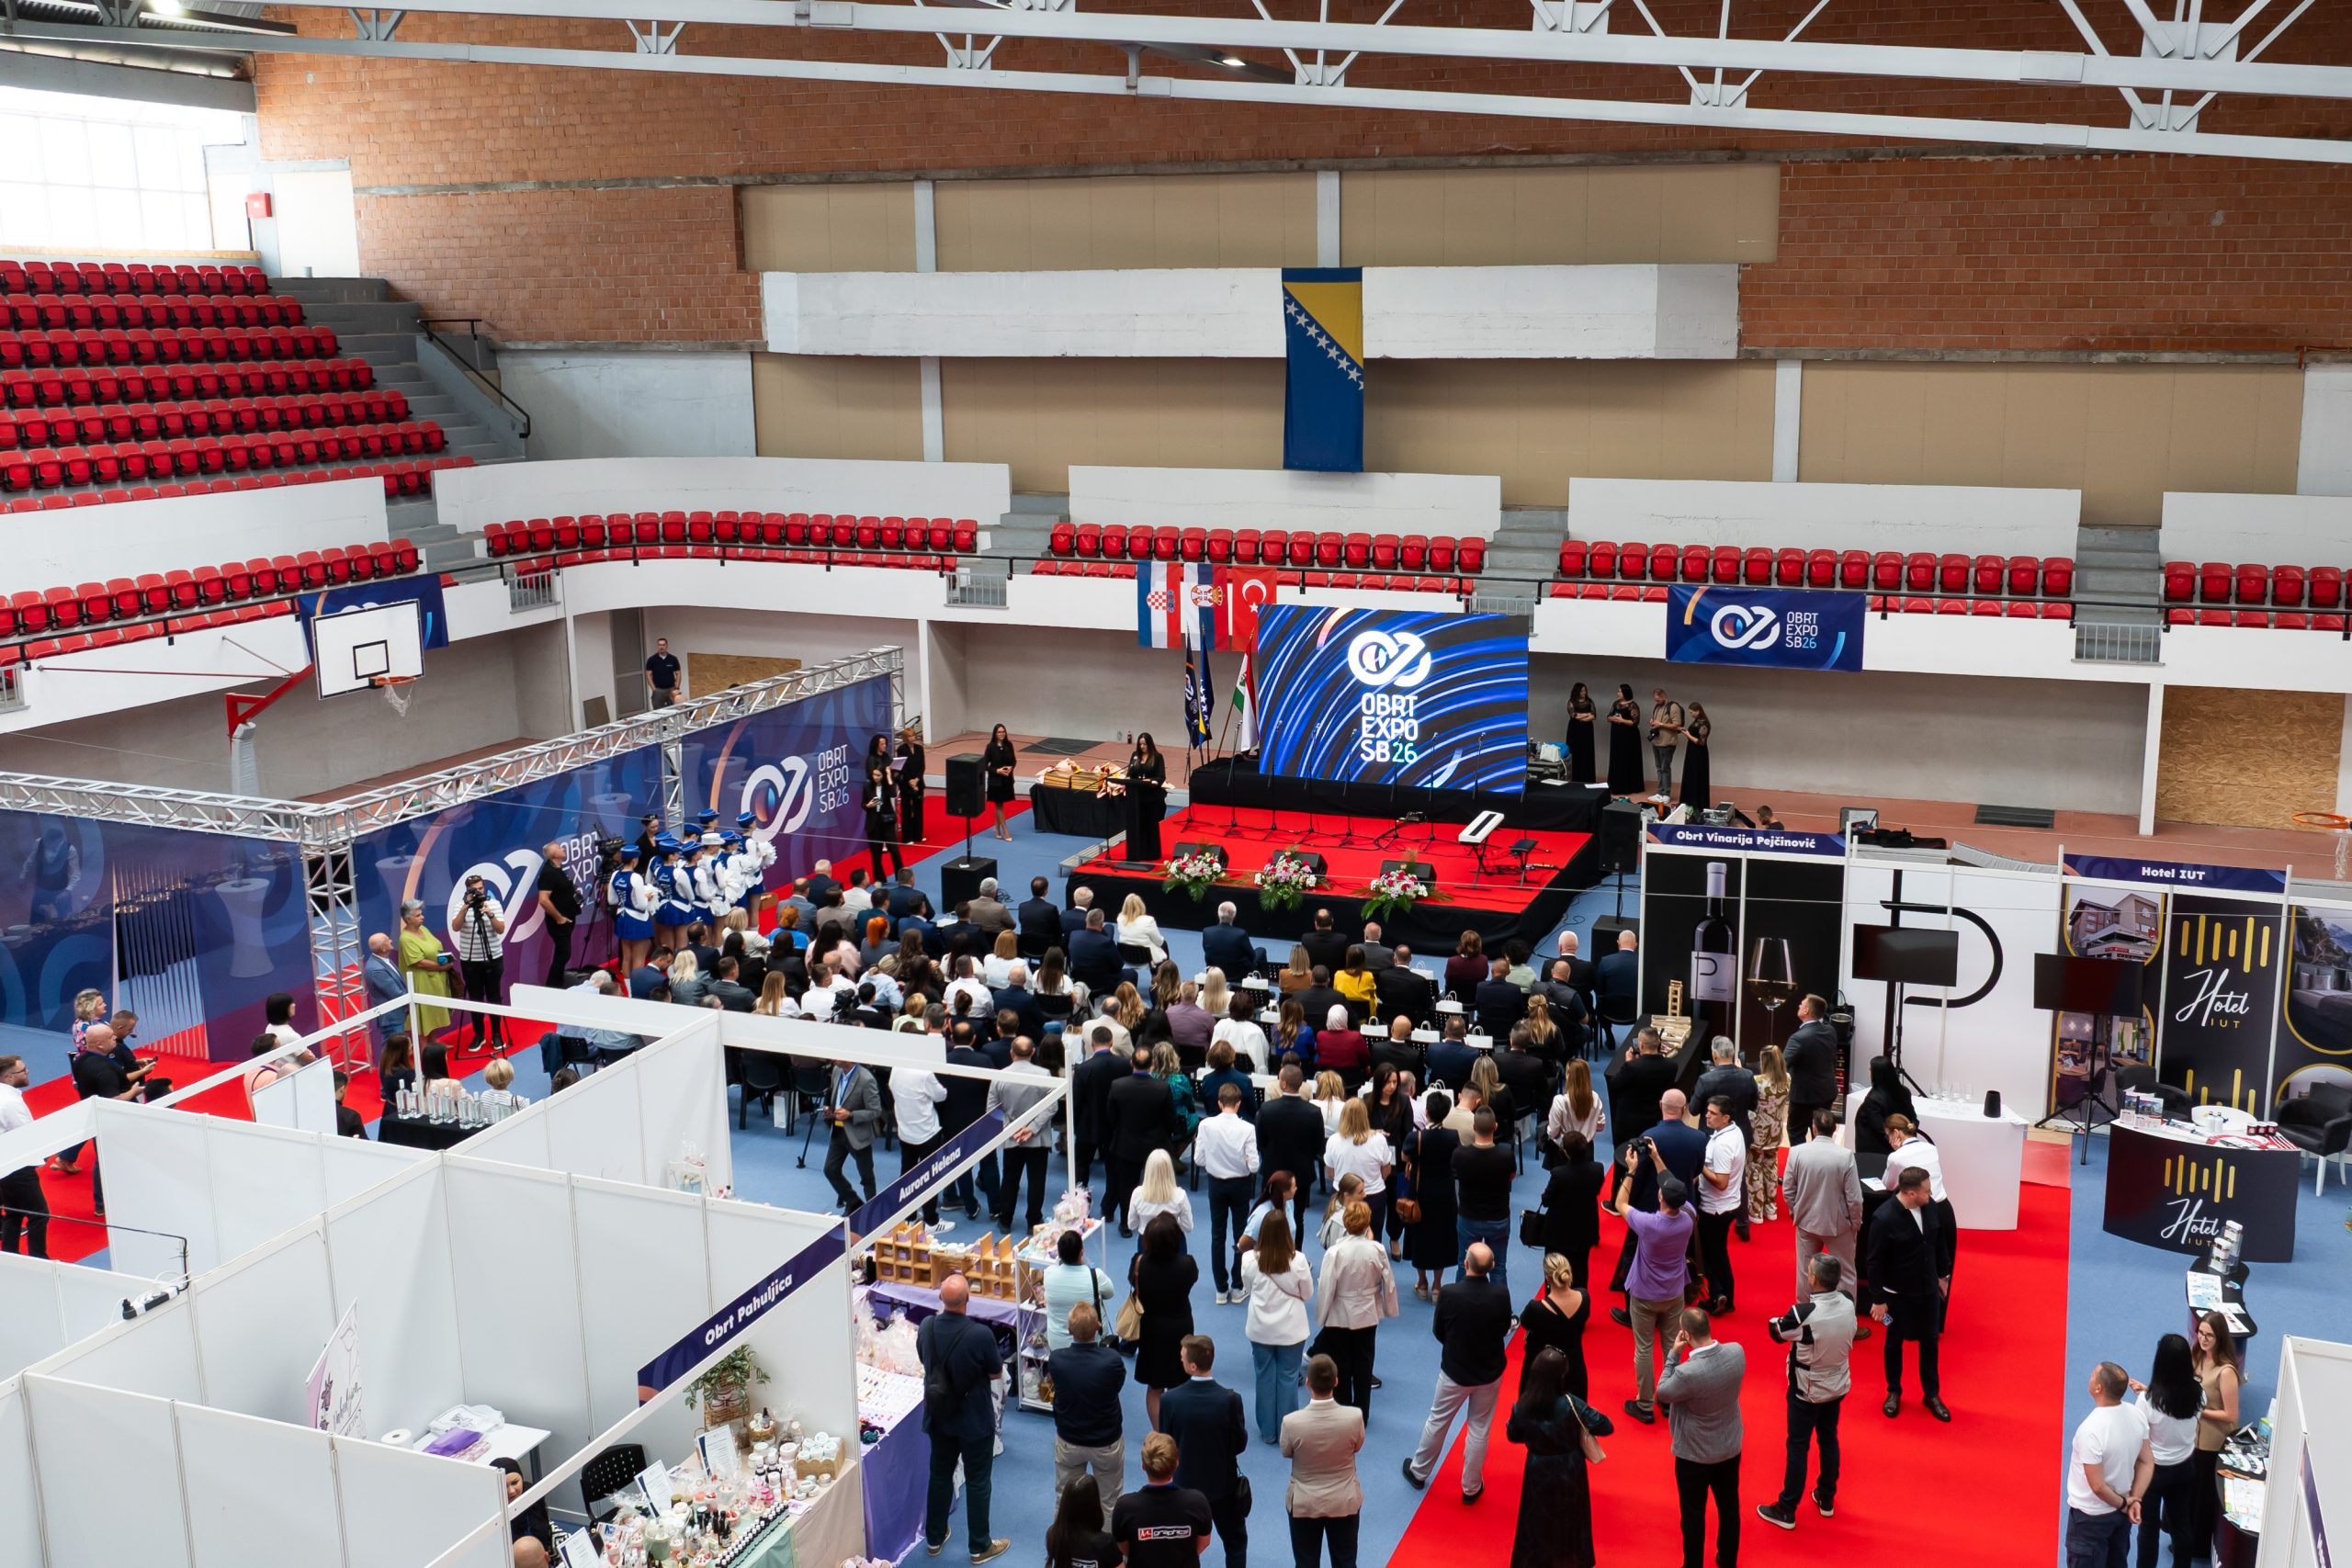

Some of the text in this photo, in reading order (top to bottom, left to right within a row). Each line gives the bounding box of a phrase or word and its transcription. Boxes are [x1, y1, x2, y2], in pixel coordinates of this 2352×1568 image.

[1786, 624, 1818, 637] EXPO
[1787, 611, 1819, 625] OBRT
[1785, 636, 1817, 649] SB26
[1361, 693, 1418, 716] OBRT
[1362, 716, 1419, 741] EXPO
[818, 744, 848, 772] OBRT
[1360, 739, 1418, 764] SB26
[819, 765, 849, 794] EXPO
[820, 786, 850, 813] SB26
[1677, 830, 1815, 849] Obrt Vinarija Pejčinović
[2142, 866, 2205, 881] Hotel IUT
[2176, 968, 2250, 1027] Hotel
[2211, 1018, 2241, 1029] IUT
[899, 1146, 961, 1202] Aurora Helena
[2161, 1199, 2220, 1245] Hotel
[705, 1274, 793, 1345] Obrt Pahuljica
